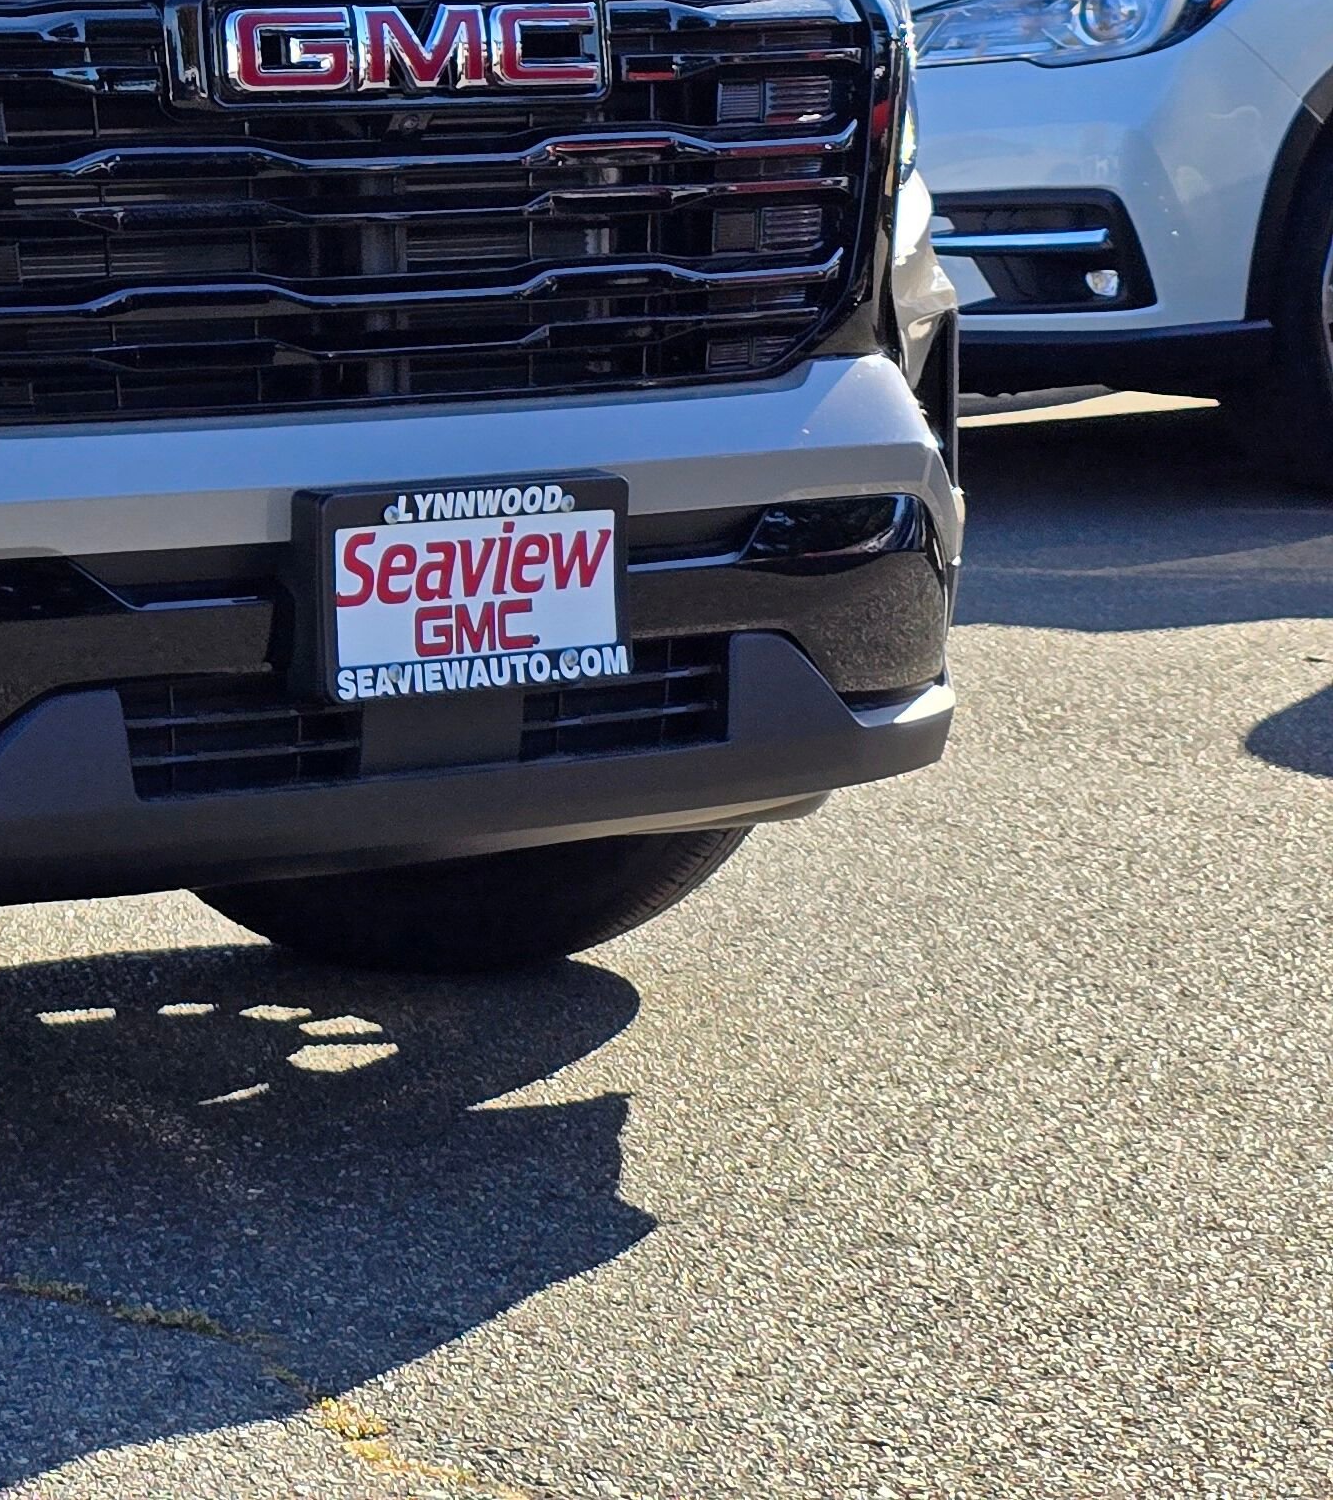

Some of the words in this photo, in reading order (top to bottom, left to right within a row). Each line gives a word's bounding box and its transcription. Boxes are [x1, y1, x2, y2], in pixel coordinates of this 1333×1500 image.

[226, 3, 600, 91] GMC
[397, 485, 563, 521] LYNNWOOD
[336, 520, 611, 608] Seaview
[414, 598, 534, 657] GMC
[337, 645, 628, 700] SEAVIEWAUTO.COM
